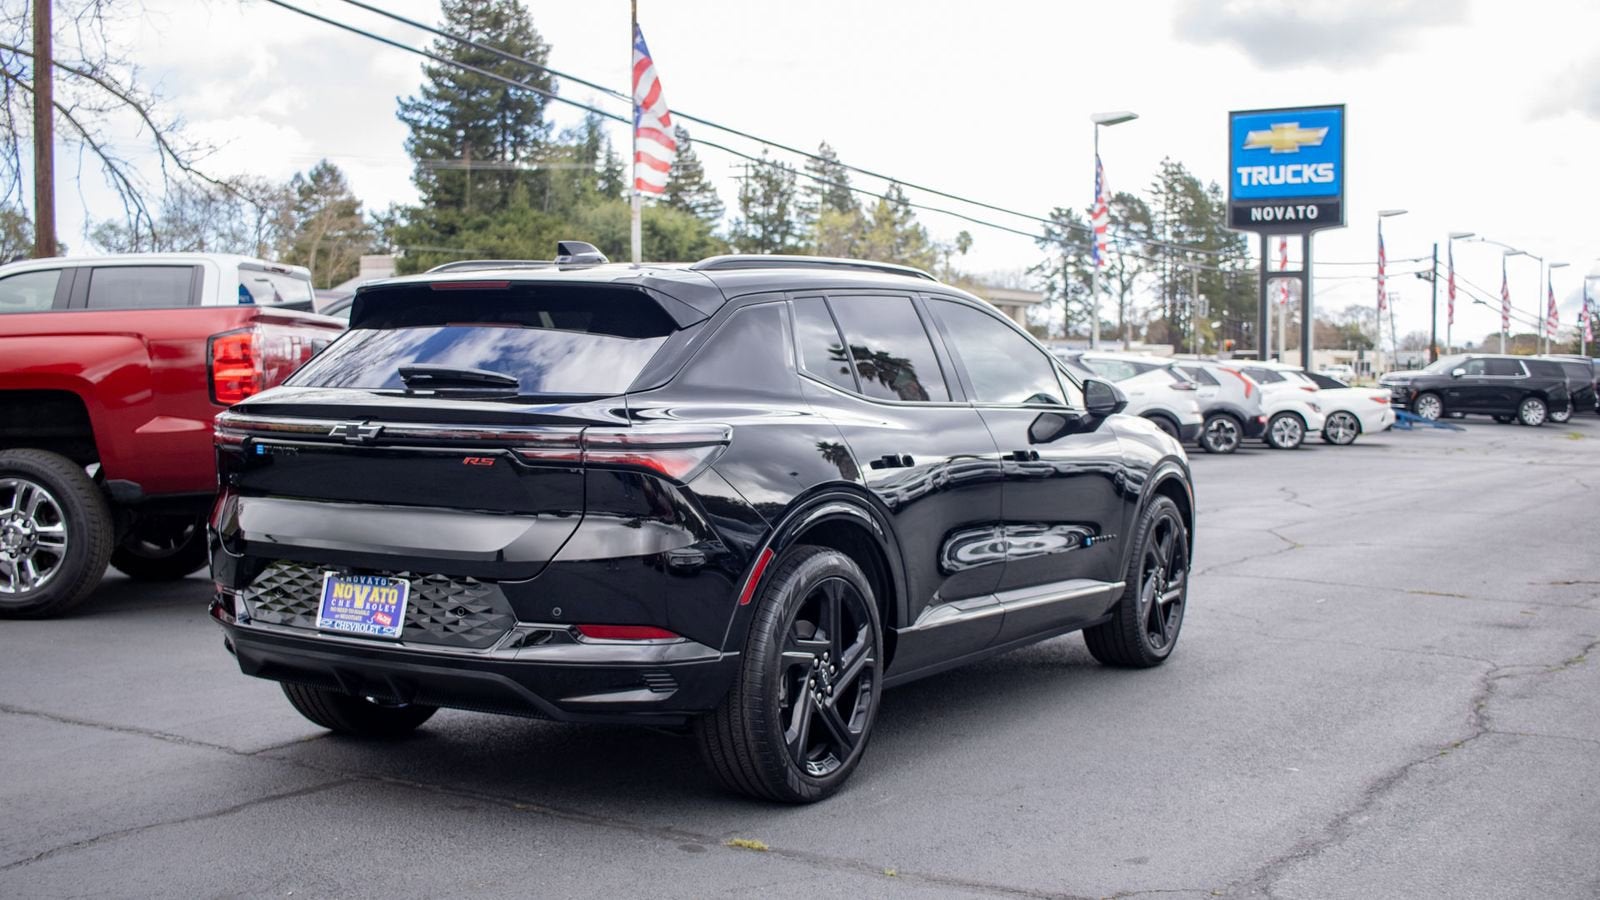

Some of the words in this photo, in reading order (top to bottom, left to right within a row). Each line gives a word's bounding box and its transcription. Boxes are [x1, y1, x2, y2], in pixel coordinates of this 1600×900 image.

[1237, 163, 1335, 186] TRUCKS
[1251, 205, 1319, 221] NOVATO
[463, 457, 496, 466] RS
[346, 576, 387, 586] NOVATO
[333, 582, 399, 609] NOVATO
[334, 621, 379, 634] CHEVROLET
